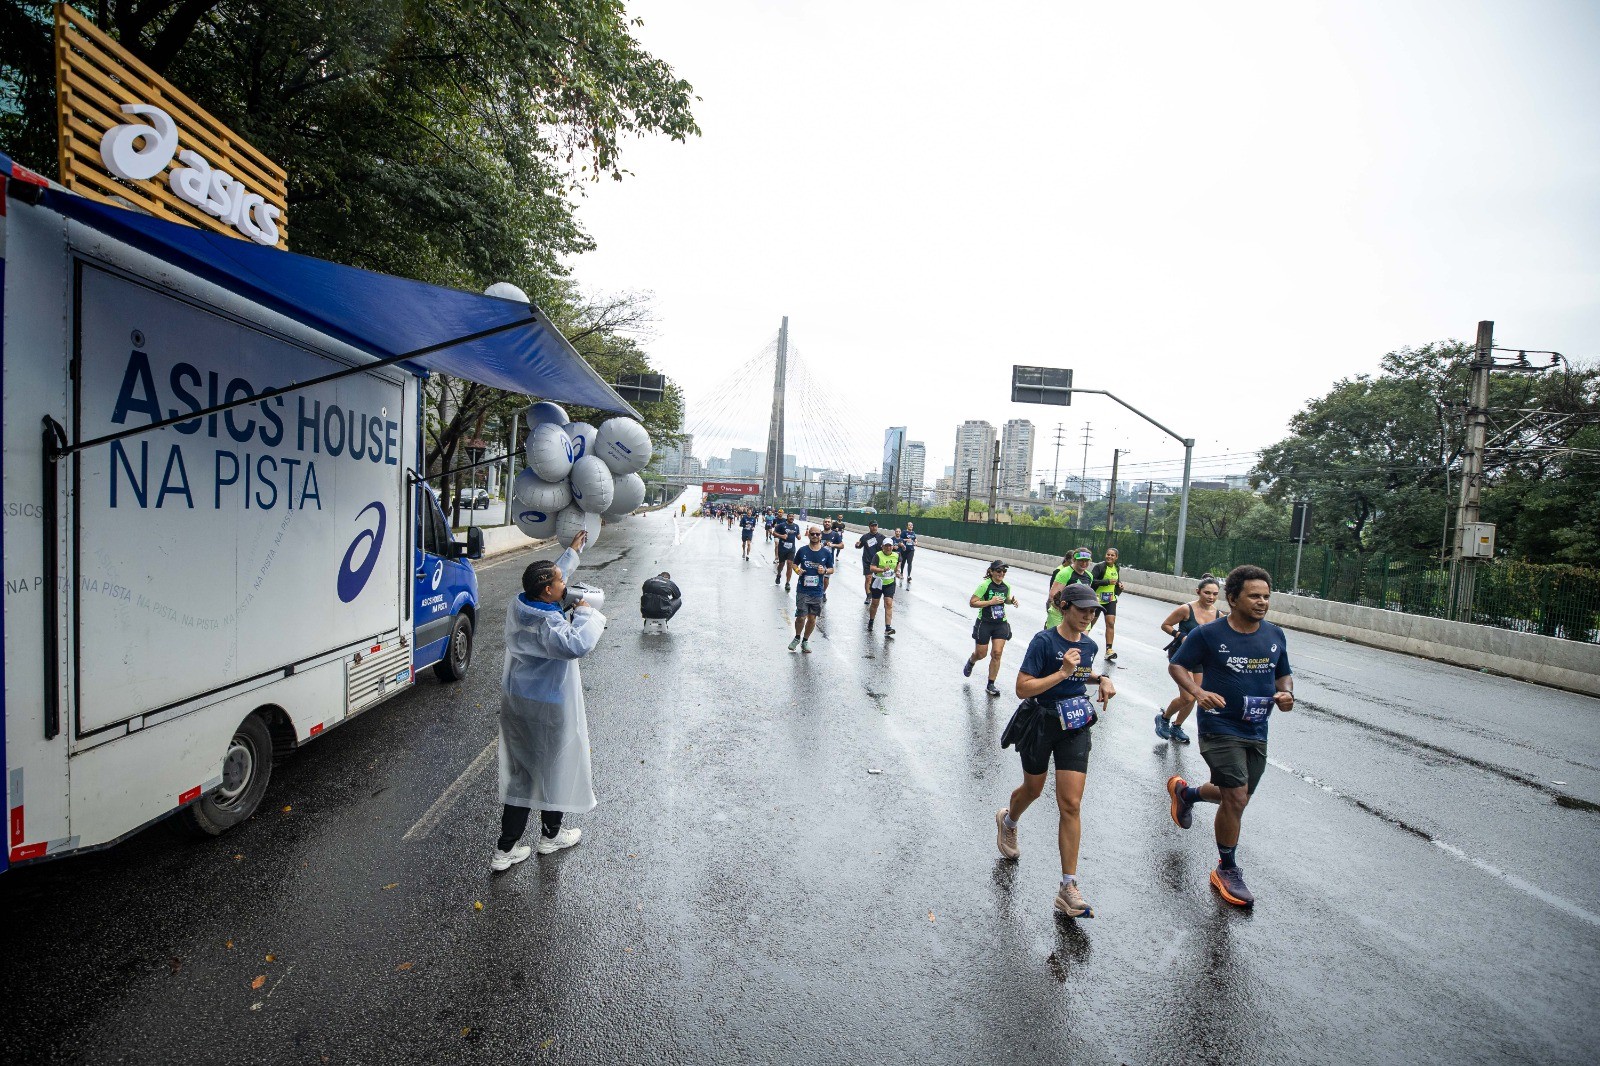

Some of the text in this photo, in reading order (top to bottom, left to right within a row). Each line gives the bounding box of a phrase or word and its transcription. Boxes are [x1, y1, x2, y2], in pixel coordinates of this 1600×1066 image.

[169, 150, 281, 246] asics
[111, 349, 398, 466] ASICS HOUSE
[109, 439, 322, 510] NA PISTA
[81, 577, 98, 592] NA
[101, 581, 131, 602] PISTA
[1226, 656, 1249, 664] ASICS
[1066, 708, 1085, 720] 5140
[1249, 707, 1268, 715] 5421
